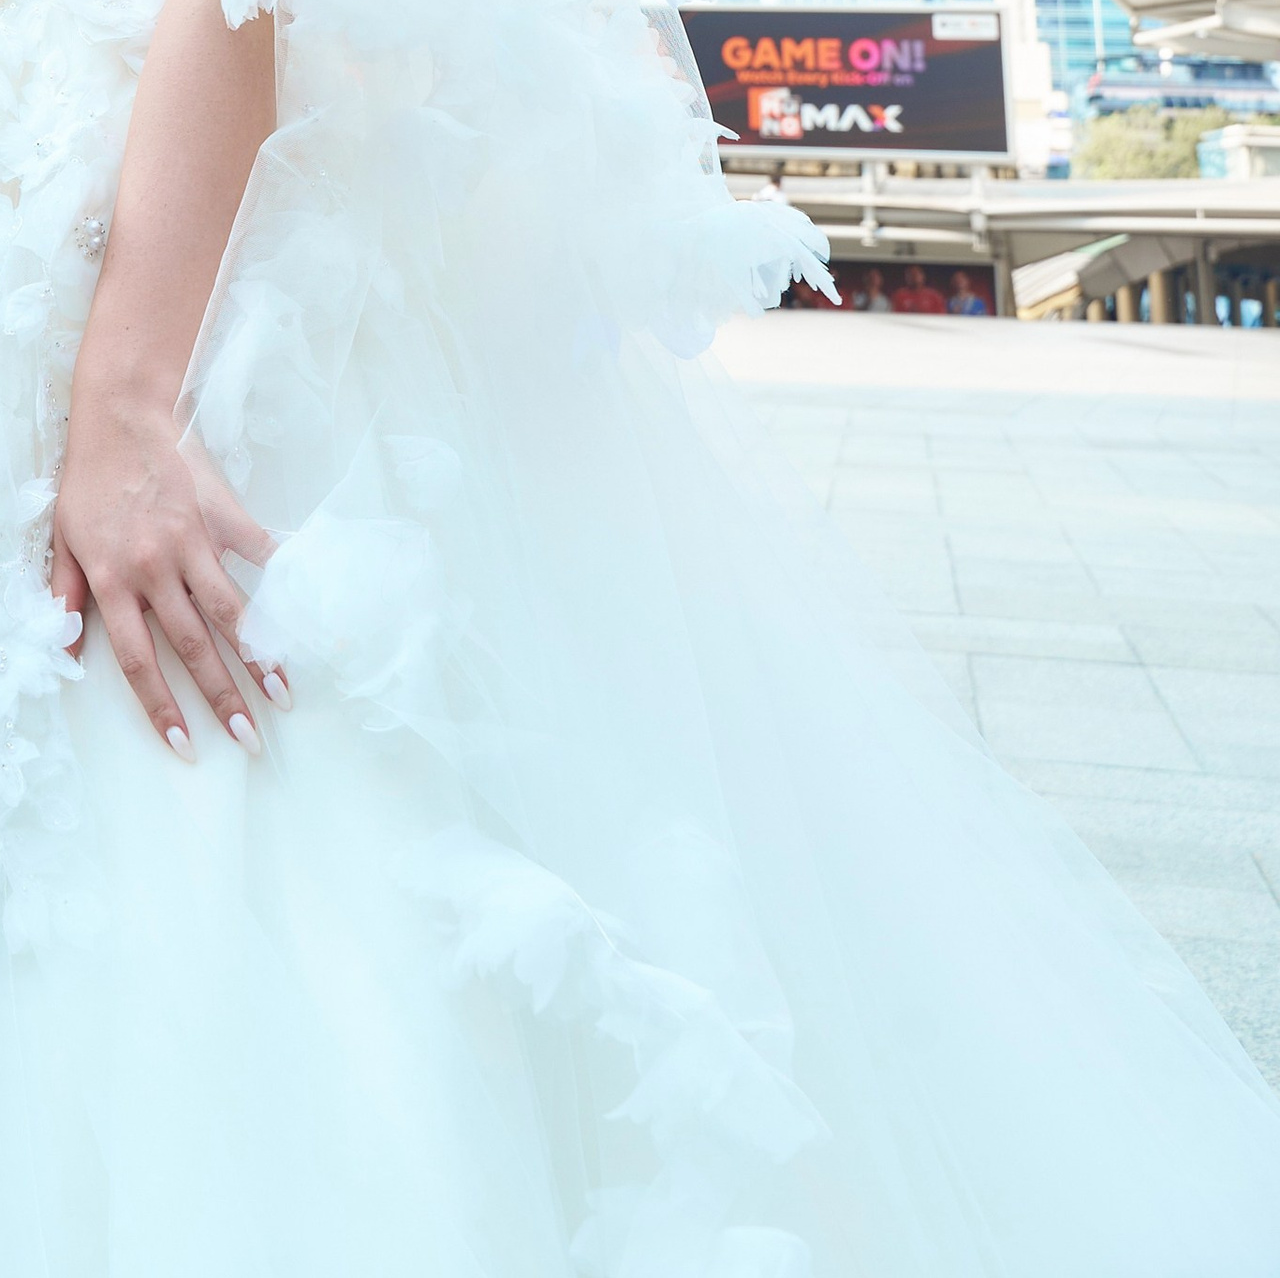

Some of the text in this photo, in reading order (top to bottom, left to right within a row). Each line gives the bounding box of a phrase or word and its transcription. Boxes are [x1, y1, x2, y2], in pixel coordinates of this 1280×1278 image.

[722, 36, 926, 72] GAME ON!
[801, 103, 904, 133] MAX
